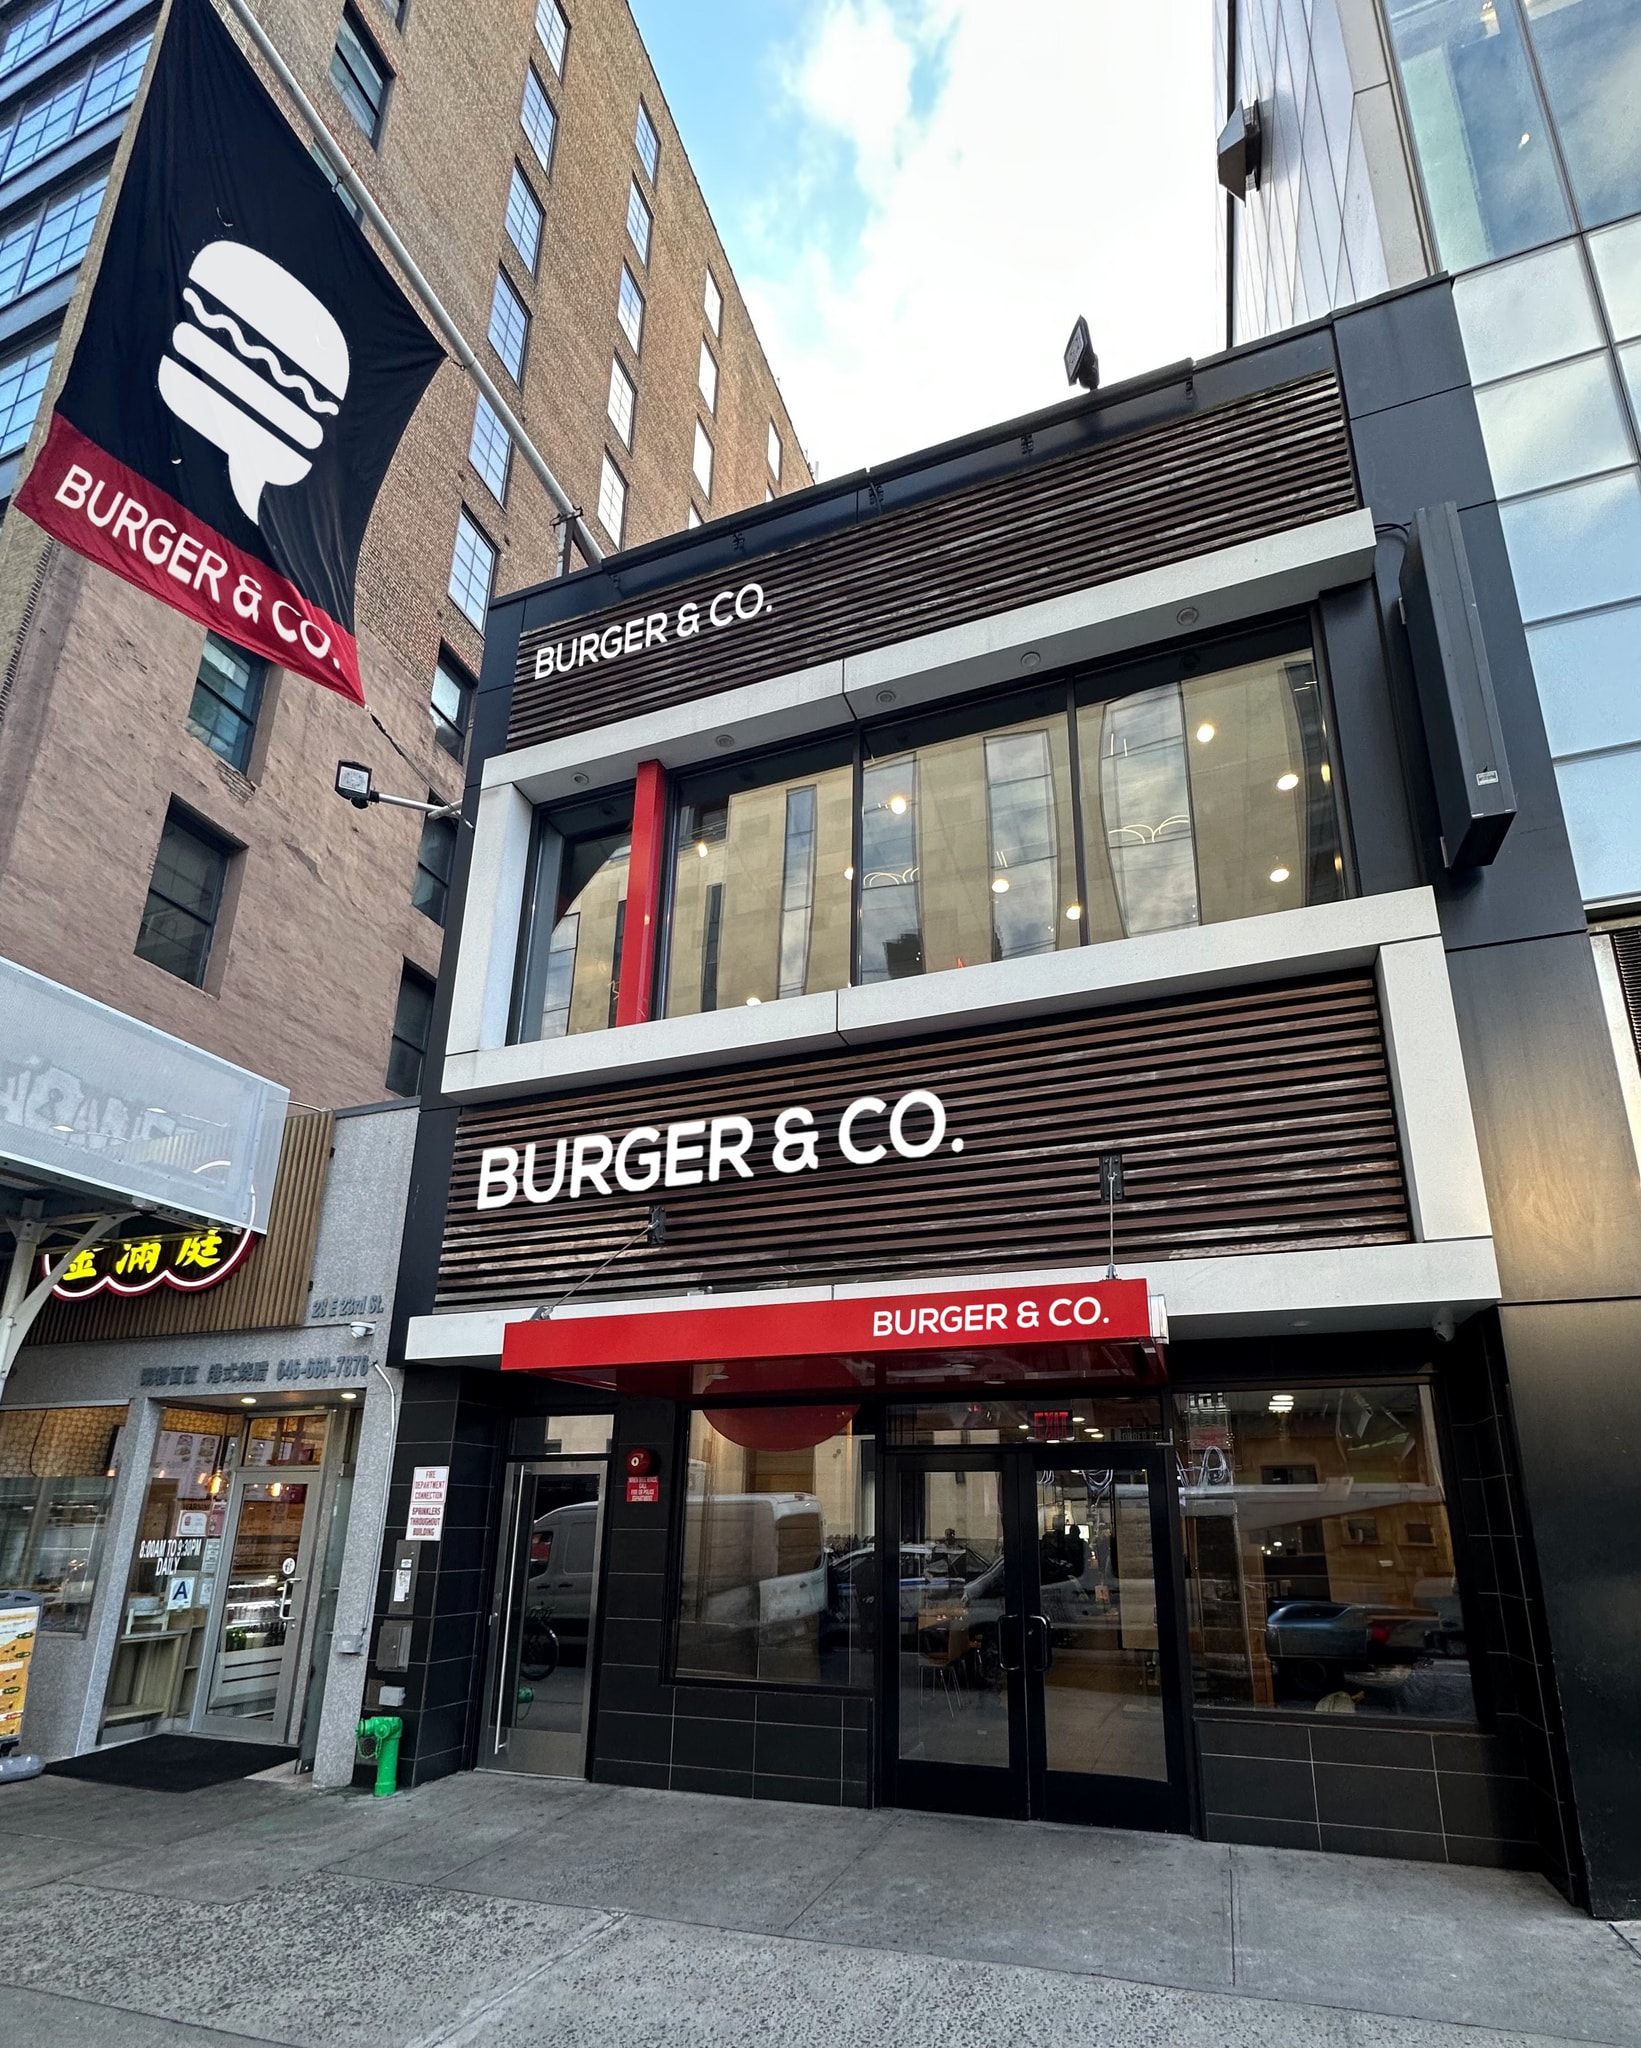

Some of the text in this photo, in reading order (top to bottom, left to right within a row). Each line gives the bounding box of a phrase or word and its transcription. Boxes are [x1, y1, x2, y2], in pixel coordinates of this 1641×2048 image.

[54, 463, 341, 670] BURGER & CO.
[534, 583, 773, 681] BURGER & CO.
[476, 1088, 966, 1211] BURGER & CO.
[311, 1299, 328, 1318] 28
[329, 1298, 338, 1317] E
[339, 1295, 367, 1316] 23rd
[873, 1296, 1110, 1337] BURGER & CO.
[1033, 1411, 1069, 1440] EXIT
[425, 1470, 436, 1479] FIRE
[414, 1480, 445, 1490] DEPARTMENT
[414, 1491, 443, 1500] CONNECTION
[411, 1507, 441, 1516] SPRINKLERS
[410, 1517, 441, 1527] THROUGHOUT
[412, 1527, 435, 1537] BUILDING
[139, 1539, 167, 1559] 8:00AM
[166, 1539, 177, 1557] TO
[176, 1539, 202, 1557] 9:30PM
[154, 1557, 181, 1577] DAILY
[172, 1581, 188, 1601] A
